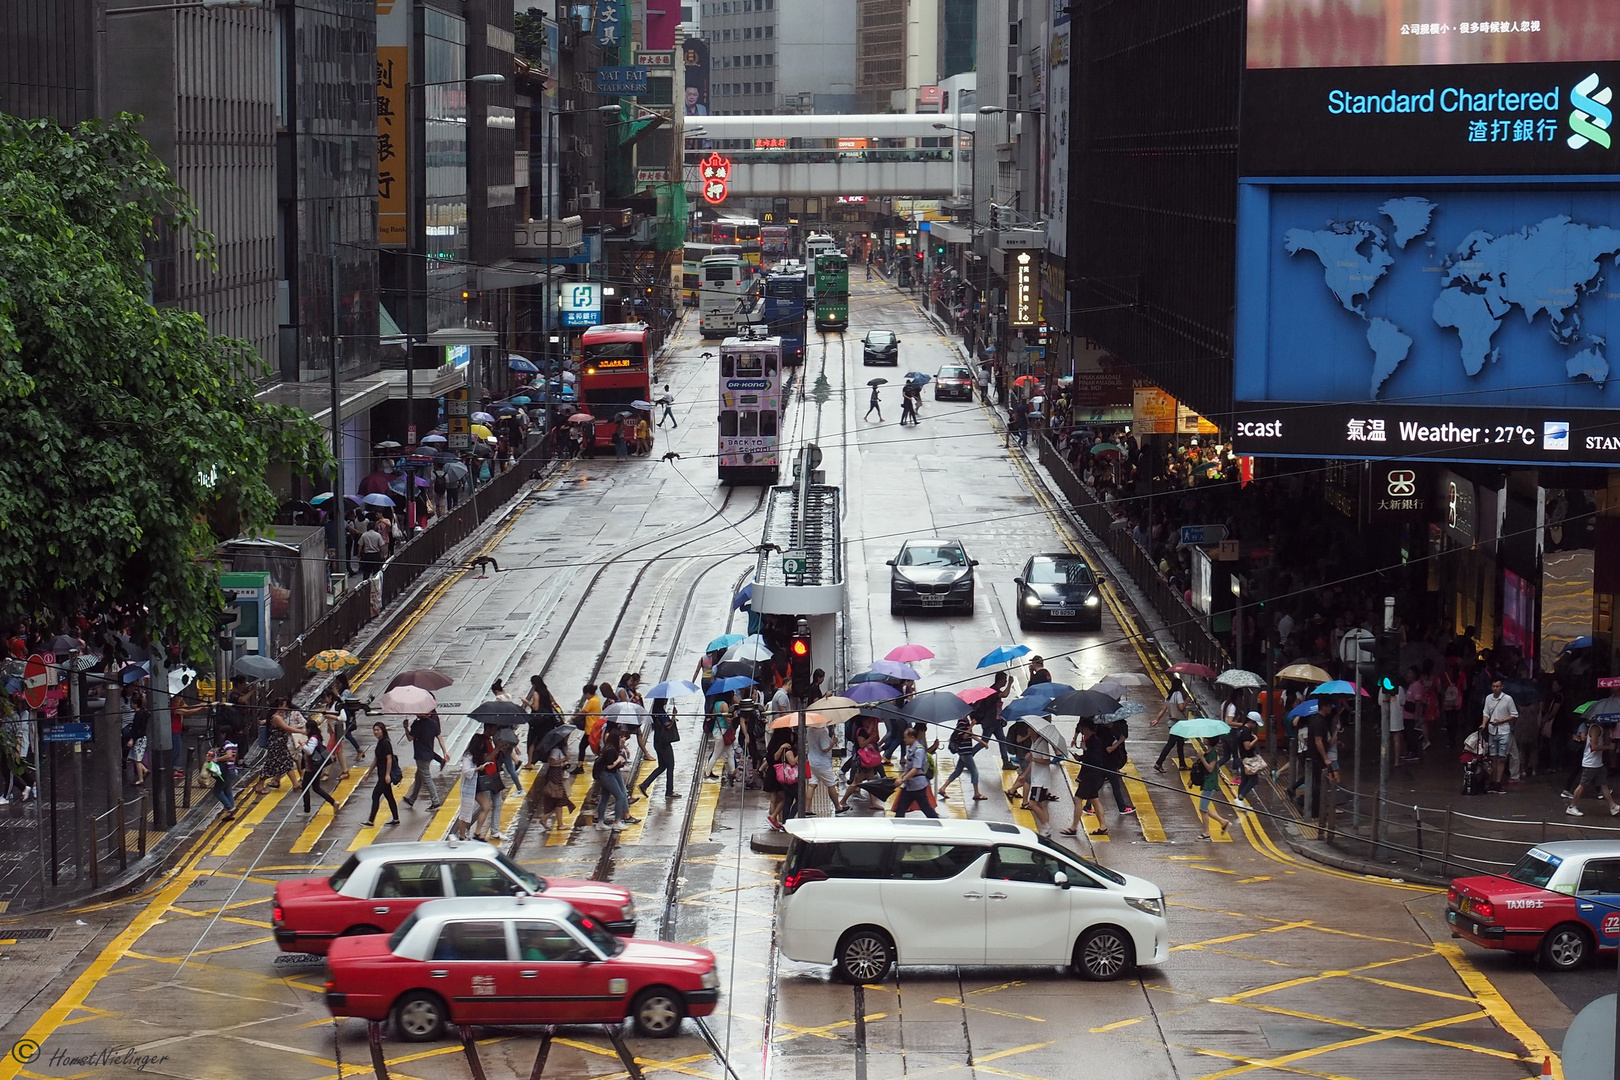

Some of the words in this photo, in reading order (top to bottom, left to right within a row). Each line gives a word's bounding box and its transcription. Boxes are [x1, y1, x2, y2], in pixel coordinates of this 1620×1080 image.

[600, 0, 619, 45] 文具
[600, 71, 619, 80] YAT
[626, 71, 644, 80] FAT
[598, 84, 647, 92] STATIONERS
[1328, 88, 1434, 114] Standard
[1440, 86, 1559, 112] Chartered
[1468, 118, 1558, 142] 渣打銀行
[1377, 499, 1425, 510] 大新銀行
[1505, 900, 1526, 909] TAXI
